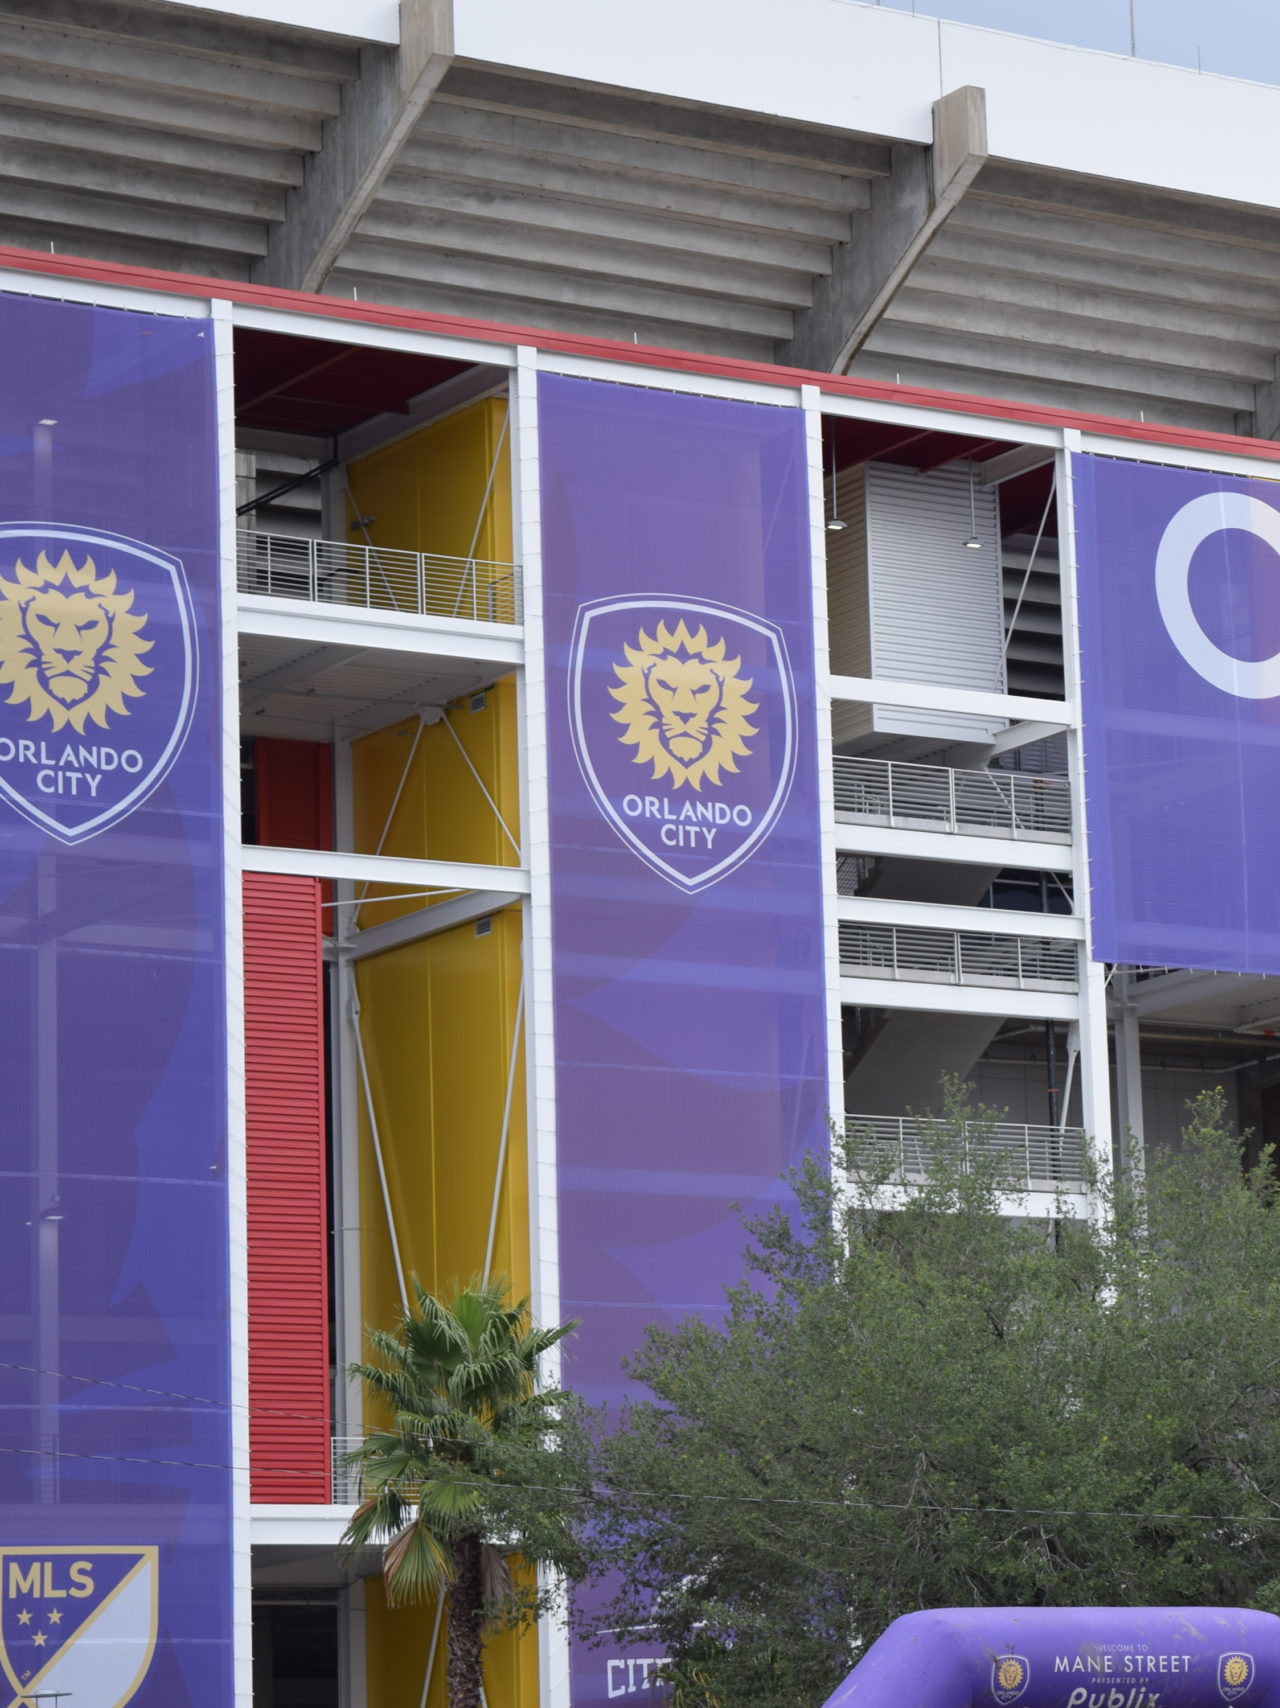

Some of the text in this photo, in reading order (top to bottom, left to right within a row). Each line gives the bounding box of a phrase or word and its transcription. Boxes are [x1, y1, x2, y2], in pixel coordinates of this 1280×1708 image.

[0, 737, 143, 773] ORLANDO
[36, 769, 102, 797] CITY
[622, 794, 752, 826] ORLANDO
[660, 824, 717, 849] CITY
[9, 1560, 95, 1599] MLS
[1137, 1644, 1149, 1652] TO
[1054, 1655, 1191, 1673] MANE STREET
[1066, 1687, 1160, 1708] Publix
